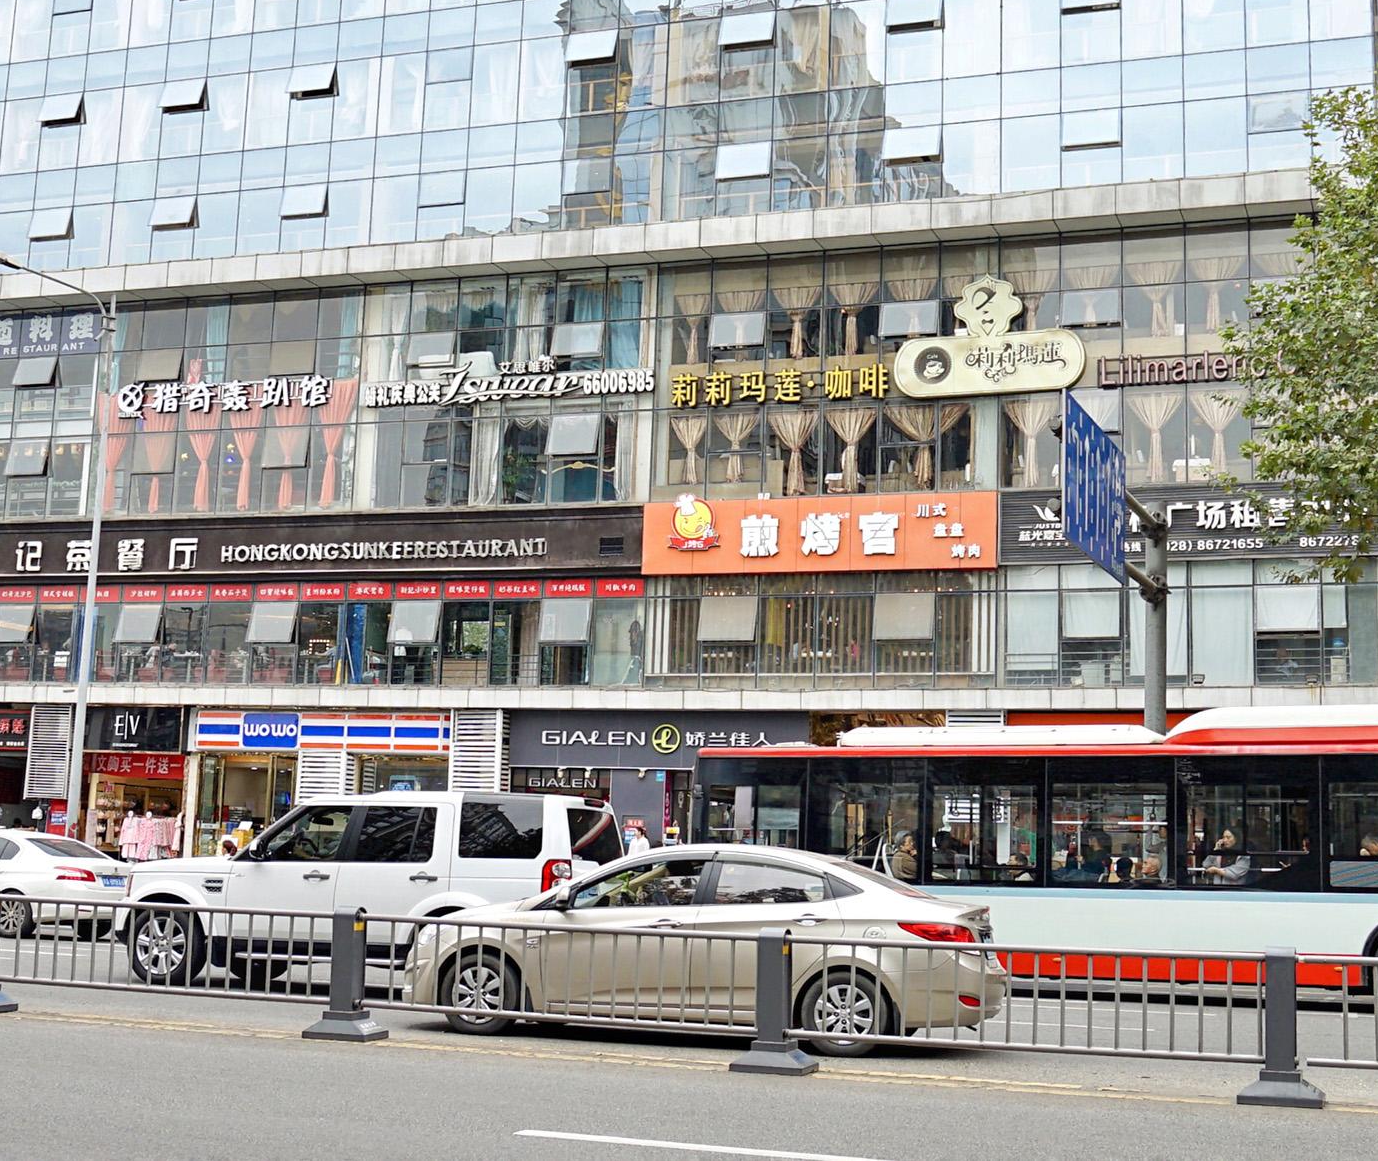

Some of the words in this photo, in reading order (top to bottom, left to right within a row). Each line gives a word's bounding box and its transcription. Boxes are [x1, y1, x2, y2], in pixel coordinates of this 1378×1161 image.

[498, 356, 557, 375] 艾思唯尔
[583, 369, 655, 395] 66006985
[152, 375, 329, 413] 猎奇轰趴馆
[916, 502, 948, 518] 川式
[951, 543, 981, 559] 烤肉
[1197, 538, 1264, 550] 86721655
[685, 731, 772, 747] 娇兰佳人
